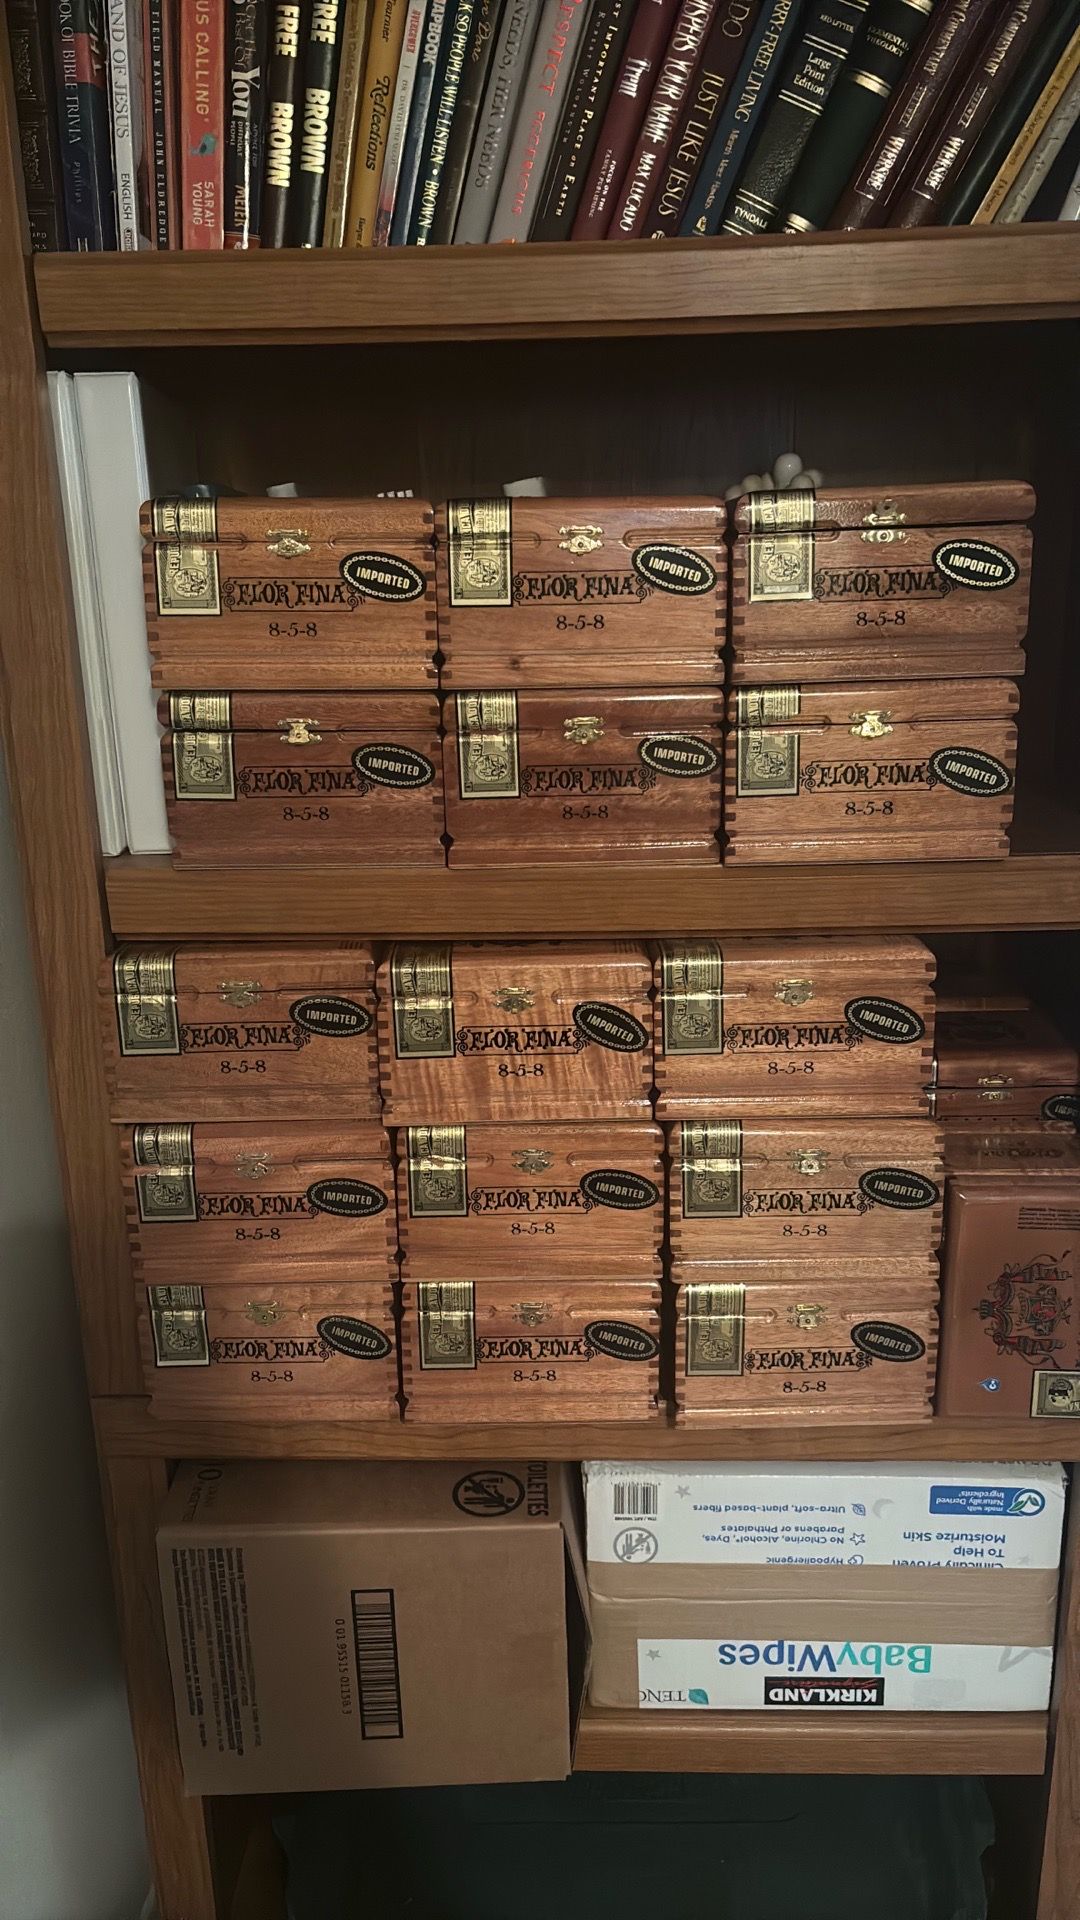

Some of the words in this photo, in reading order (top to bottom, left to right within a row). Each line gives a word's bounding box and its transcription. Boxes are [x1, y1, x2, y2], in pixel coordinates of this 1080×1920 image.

[456, 13, 470, 33] SO
[722, 0, 751, 38] DO
[152, 11, 161, 52] FIELD
[275, 5, 300, 58] FREE
[112, 49, 127, 76] OF
[444, 33, 468, 84] PEOPLE
[588, 25, 619, 103] IMPORTANT
[807, 51, 832, 70] Large
[63, 50, 79, 91] BIBLE
[656, 57, 694, 101] YOUR
[802, 64, 827, 83] Print
[153, 60, 163, 114] MANUAL
[231, 66, 261, 118] You
[694, 69, 726, 120] JUST
[734, 70, 766, 123] LIVING
[793, 75, 825, 97] Edition
[114, 81, 130, 139] JESUS
[438, 85, 458, 117] WILL
[66, 96, 82, 144] TRIVIA
[300, 87, 331, 175] BROWN
[366, 75, 391, 171] Reflections
[574, 109, 595, 150] PLACE
[156, 132, 165, 165] JOHN
[267, 102, 294, 188] BROWN
[429, 118, 452, 166] LISTEN
[676, 120, 708, 165] LIKE
[635, 151, 657, 181] MAX
[866, 134, 906, 192] WIERSBE
[924, 135, 966, 193] WIERSBE
[121, 173, 133, 220] ENGLISH
[555, 174, 576, 217] EARTH
[658, 164, 692, 220] JESUS
[192, 182, 203, 225] YOUNG
[204, 181, 215, 228] SARAH
[418, 180, 440, 229] BROWN
[619, 180, 647, 232] LUCADO
[649, 556, 701, 583] IMPORTED
[949, 554, 1003, 577] IMPORTED
[356, 566, 410, 590] IMPORTED
[527, 576, 582, 601] FLOR
[585, 575, 635, 598] FINA
[828, 572, 884, 597] FLOR
[886, 571, 938, 593] FINA
[238, 583, 294, 608] FLOR
[298, 582, 346, 605] FINA
[556, 615, 605, 630] 8-5-8
[856, 611, 906, 626] 8-5-8
[269, 622, 318, 638] 8-5-8
[368, 757, 420, 776] IMPORTED
[654, 747, 705, 766] IMPORTED
[250, 771, 304, 794] FLOR
[306, 769, 356, 791] FINA
[534, 769, 588, 793] FLOR
[590, 768, 638, 790] FINA
[818, 765, 875, 788] FLOR
[876, 763, 925, 786] FINA
[945, 760, 998, 785] IMPORTED
[283, 807, 330, 821] 8-5-8
[562, 805, 609, 819] 8-5-8
[845, 801, 893, 816] 8-5-8
[306, 1009, 357, 1026] IMPORTED
[587, 1014, 634, 1042] IMPORTED
[859, 1009, 910, 1034] IMPORTED
[186, 1026, 241, 1049] FLOR
[243, 1026, 292, 1046] FINA
[469, 1027, 522, 1053] FLOR
[523, 1027, 571, 1049] FINA
[739, 1026, 792, 1049] FLOR
[796, 1025, 844, 1047] FINA
[220, 1061, 266, 1074] 8-5-8
[498, 1064, 544, 1077] 8-5-8
[768, 1062, 814, 1075] 8-5-8
[323, 1190, 372, 1206] IMPORTED
[484, 1190, 536, 1211] FLOR
[536, 1188, 581, 1208] FINA
[596, 1182, 645, 1200] IMPORTED
[874, 1181, 923, 1199] IMPORTED
[204, 1195, 257, 1217] FLOR
[259, 1195, 307, 1214] FINA
[756, 1191, 806, 1213] FLOR
[809, 1191, 856, 1209] FINA
[235, 1228, 281, 1241] 8-5-8
[511, 1222, 555, 1235] 8-5-8
[782, 1224, 828, 1237] 8-5-8
[331, 1325, 378, 1348] IMPORTED
[599, 1330, 646, 1351] IMPORTED
[865, 1331, 911, 1352] IMPORTED
[221, 1340, 271, 1361] FLOR
[272, 1339, 318, 1358] FINA
[486, 1338, 534, 1359] FLOR
[536, 1337, 583, 1357] FINA
[758, 1350, 806, 1370] FLOR
[809, 1349, 855, 1368] FINA
[251, 1370, 293, 1383] 8-5-8
[513, 1370, 556, 1382] 8-5-8
[783, 1381, 826, 1394] 8-5-8
[692, 1503, 723, 1514] fibers
[724, 1503, 789, 1514] plant-based
[790, 1503, 847, 1515] Ultra-soft,
[935, 1497, 967, 1505] Derived
[967, 1505, 984, 1513] with
[968, 1497, 1004, 1507] Naturally
[985, 1505, 1004, 1513] made
[701, 1533, 731, 1544] Dyes,
[720, 1524, 780, 1535] Phthalates
[780, 1535, 828, 1545] Chlorine,
[793, 1525, 845, 1535] Parabens
[829, 1536, 845, 1545] No
[903, 1530, 933, 1543] Skin
[935, 1531, 1006, 1544] Moisturize
[766, 1555, 845, 1566] Hypoallergenic
[953, 1546, 985, 1557] Help
[988, 1547, 1005, 1558] To
[717, 1639, 933, 1675] BabyWipes
[768, 1687, 878, 1703] KIRKLAND
